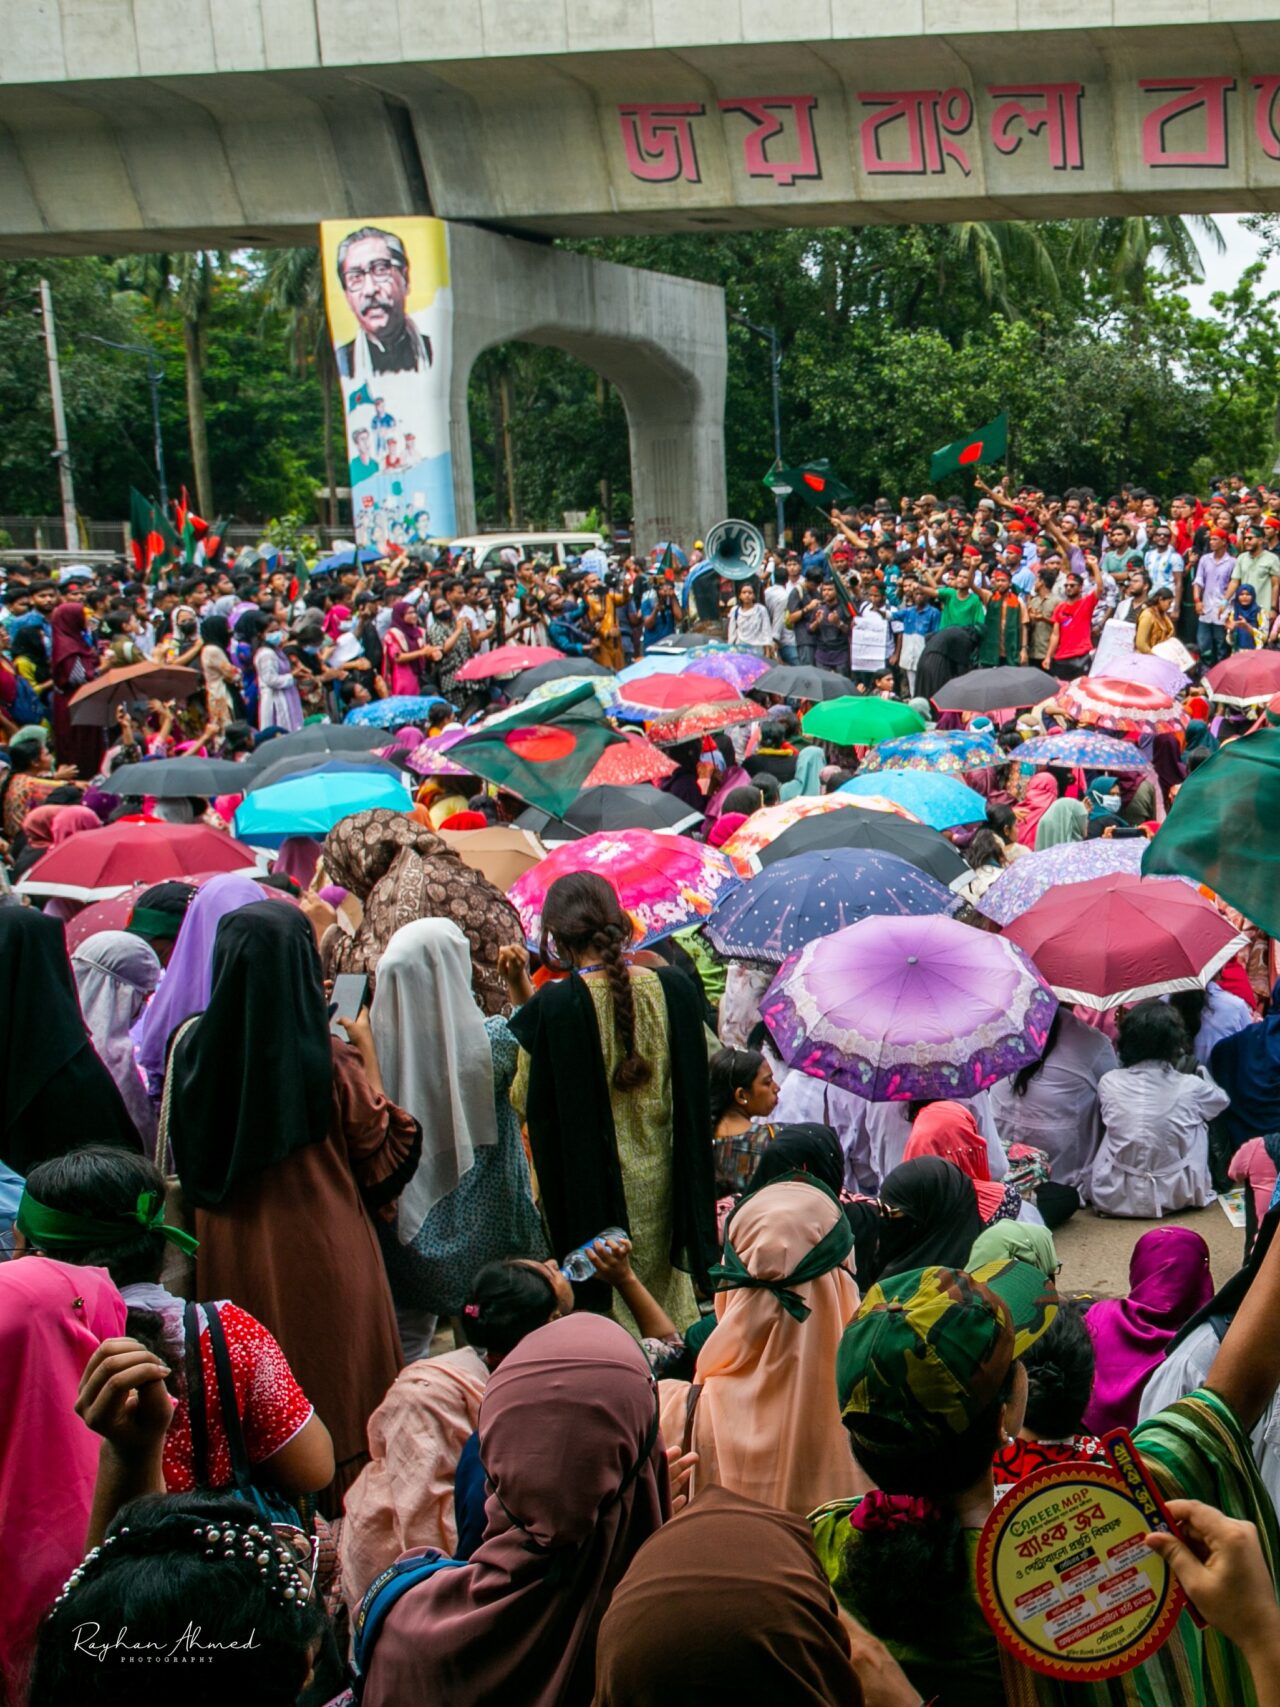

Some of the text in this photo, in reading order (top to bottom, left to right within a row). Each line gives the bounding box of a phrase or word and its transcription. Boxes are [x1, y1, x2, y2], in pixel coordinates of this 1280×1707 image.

[617, 94, 822, 186] জয়
[857, 81, 1085, 176] বাংলা
[1010, 1503, 1061, 1537] CAREER
[1061, 1488, 1089, 1510] MAP
[1014, 1521, 1068, 1558] ব্যাংক
[1068, 1502, 1106, 1532] জব
